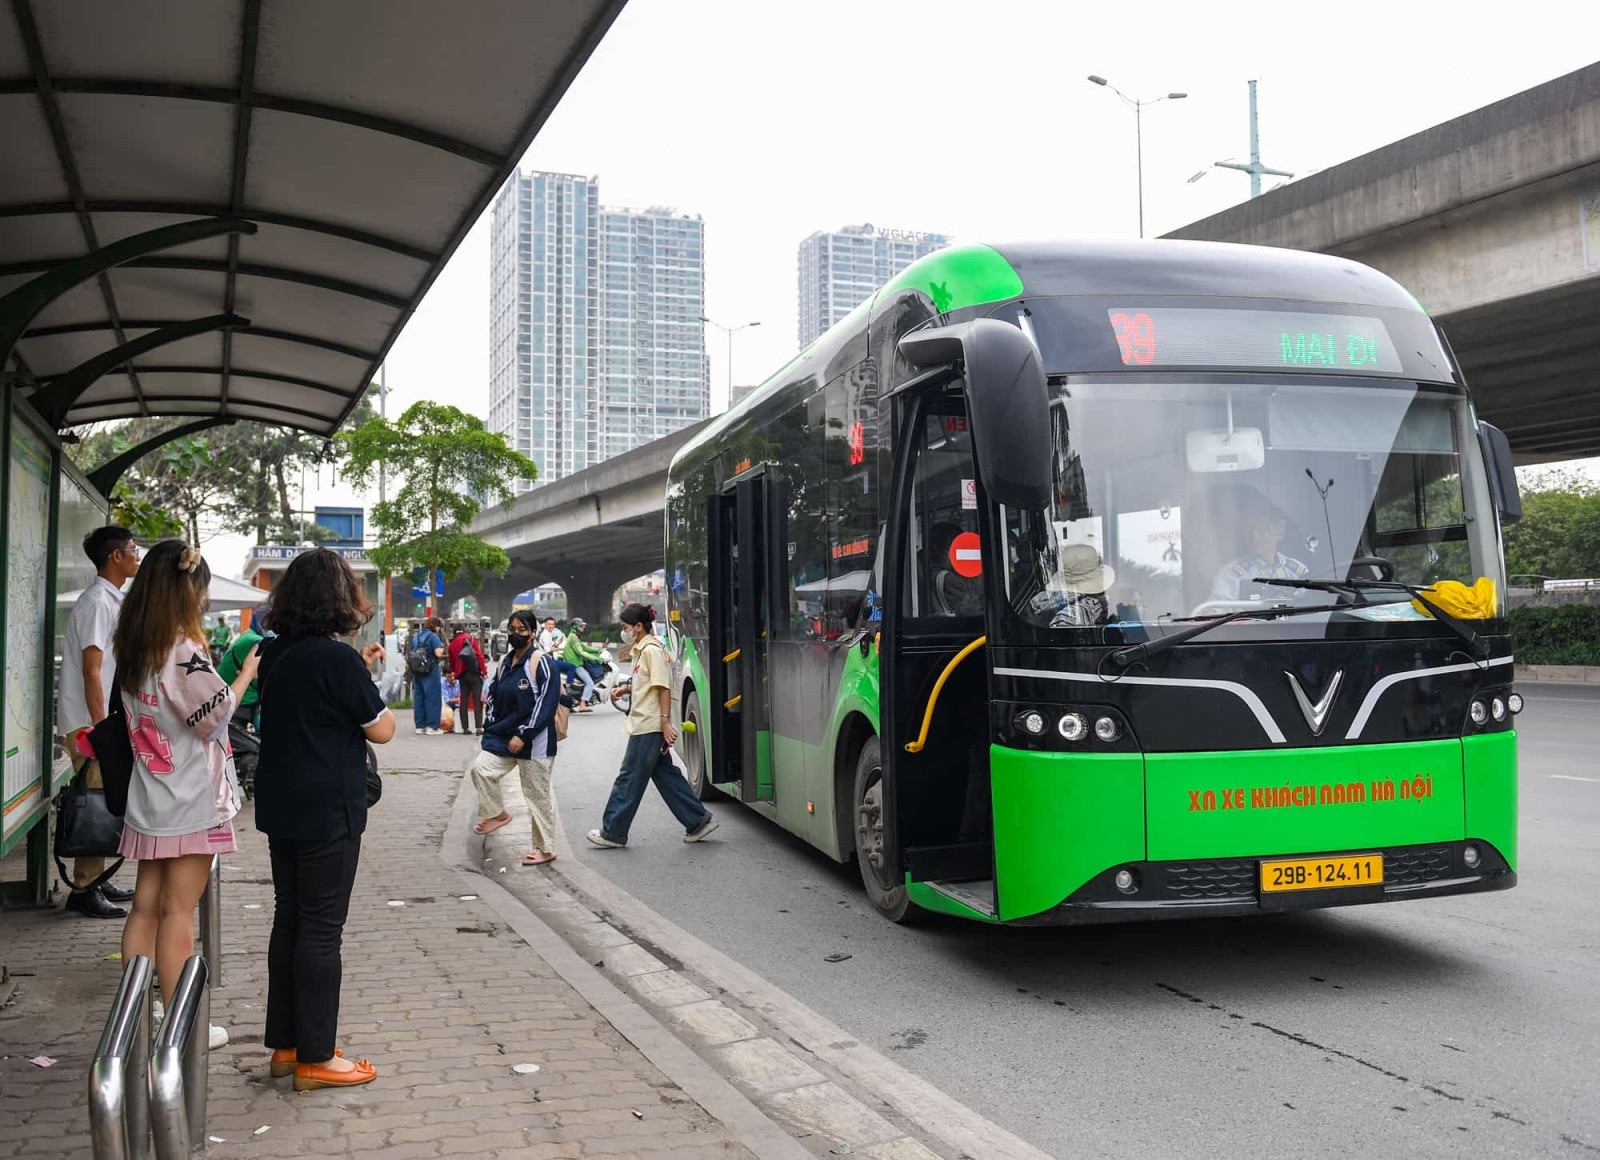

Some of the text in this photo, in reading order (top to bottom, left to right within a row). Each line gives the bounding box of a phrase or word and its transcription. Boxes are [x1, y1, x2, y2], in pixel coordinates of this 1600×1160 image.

[1281, 332, 1335, 364] MAI
[1188, 790, 1217, 811] XN
[1221, 788, 1245, 810] XE
[1251, 780, 1317, 808] KHÁCH
[1320, 783, 1366, 805] NAM
[1371, 775, 1396, 801] HÀ
[1272, 861, 1371, 886] 29B-124.11
